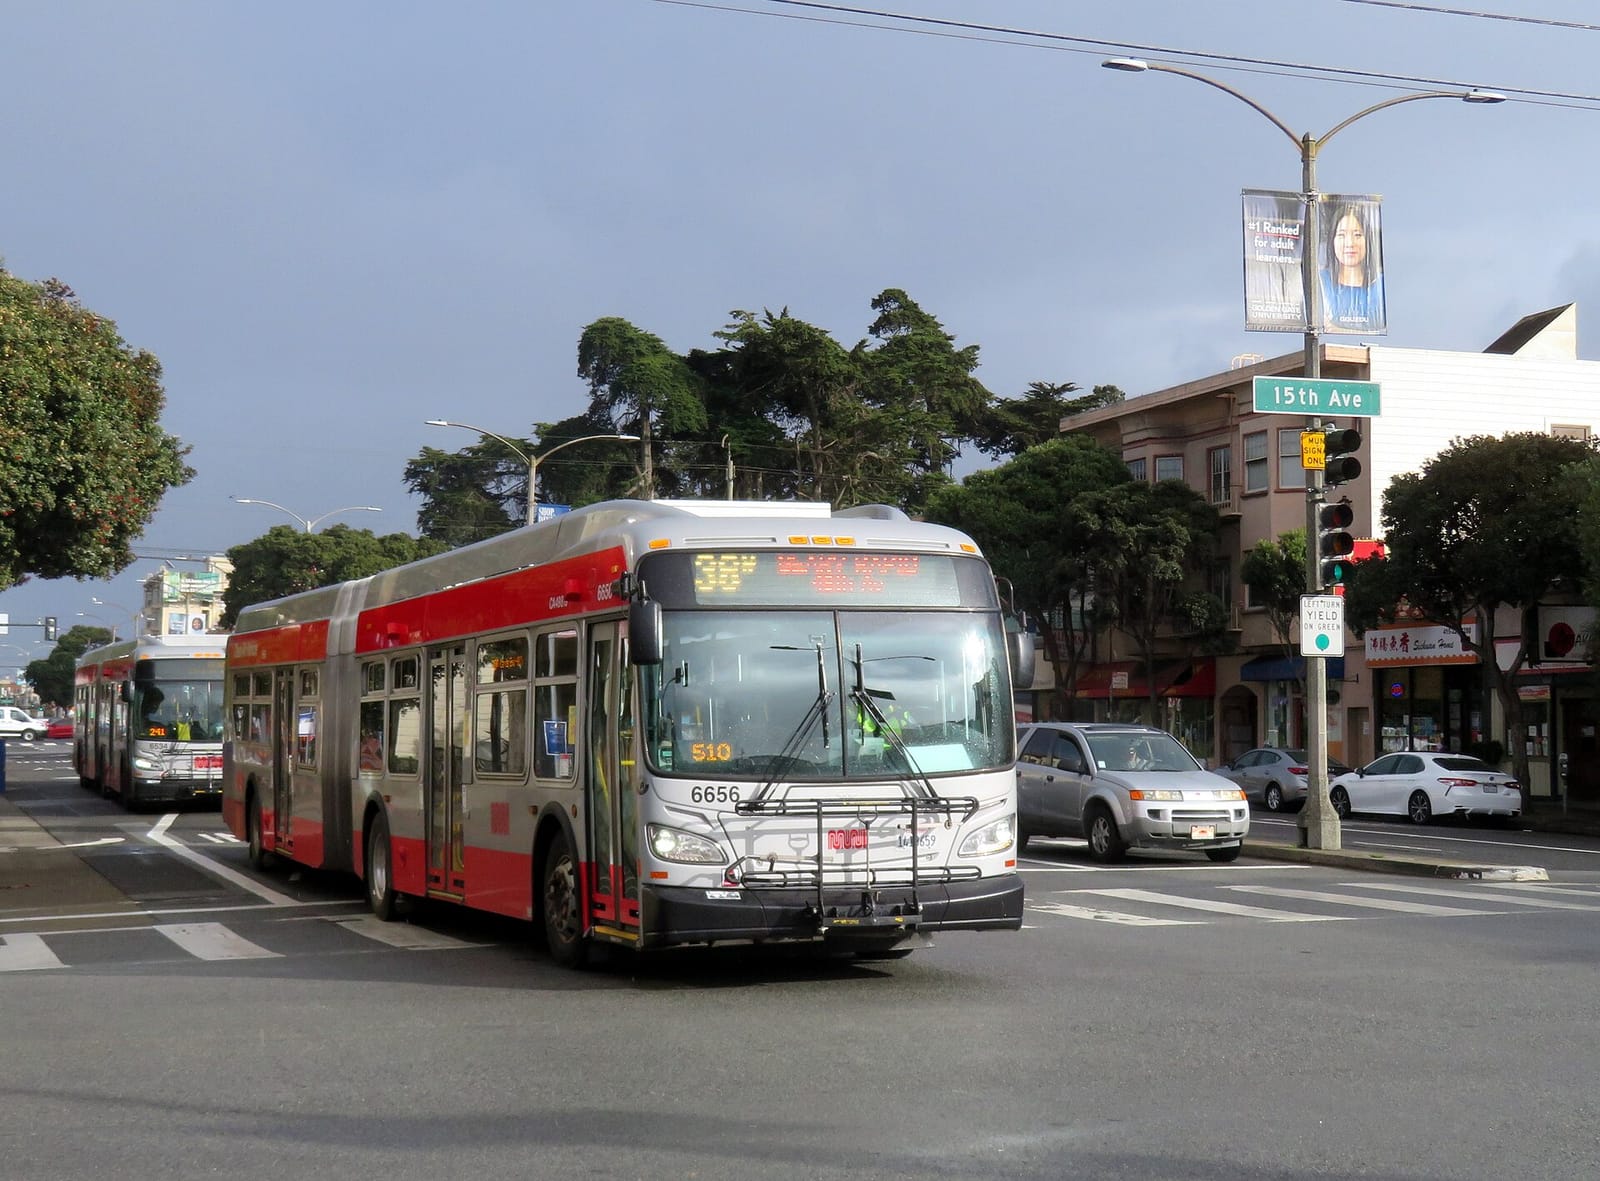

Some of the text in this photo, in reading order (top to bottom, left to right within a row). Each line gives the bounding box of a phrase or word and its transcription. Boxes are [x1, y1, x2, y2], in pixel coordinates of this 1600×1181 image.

[1248, 221, 1300, 236] #1 Ranked
[1254, 236, 1295, 250] for adult
[1256, 250, 1295, 263] learners.
[1251, 311, 1302, 320] UNIVERSITY
[1274, 386, 1362, 408] 15th Ave
[1308, 437, 1325, 445] MUN
[1307, 456, 1325, 465] ONL
[1303, 600, 1341, 609] LEFT TURN
[1306, 610, 1338, 621] YIELD
[1303, 622, 1341, 631] ON GREEN
[691, 742, 732, 762] 510
[691, 785, 741, 803] 6656
